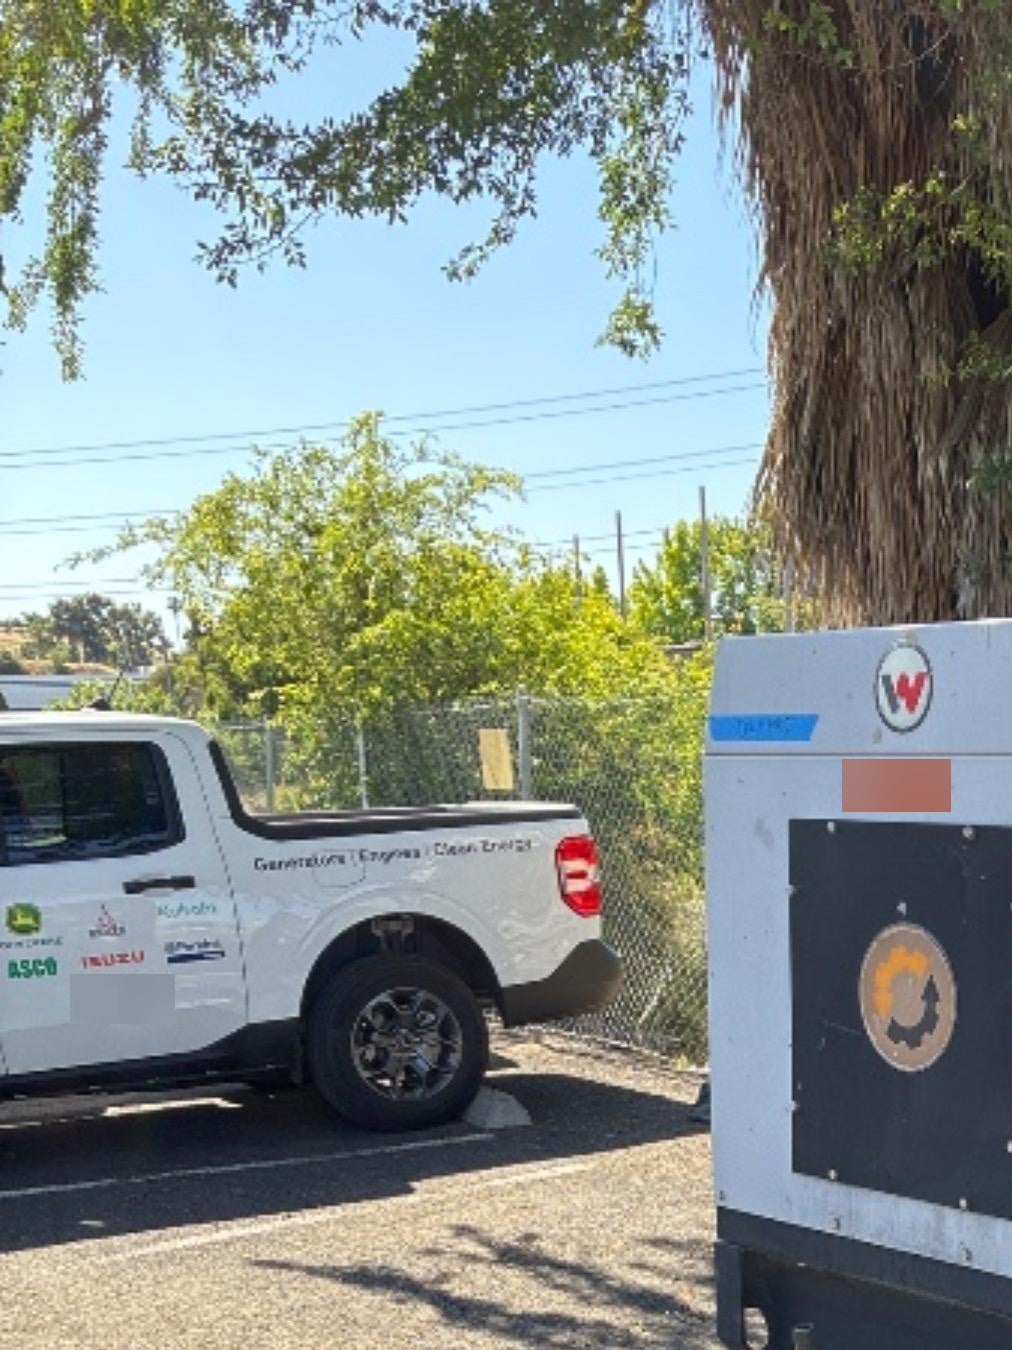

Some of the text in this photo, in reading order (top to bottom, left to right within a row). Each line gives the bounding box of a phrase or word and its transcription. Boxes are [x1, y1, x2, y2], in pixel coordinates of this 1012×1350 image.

[254, 853, 346, 872] Generators
[8, 957, 57, 979] ASCO
[81, 950, 145, 969] ISUZU
